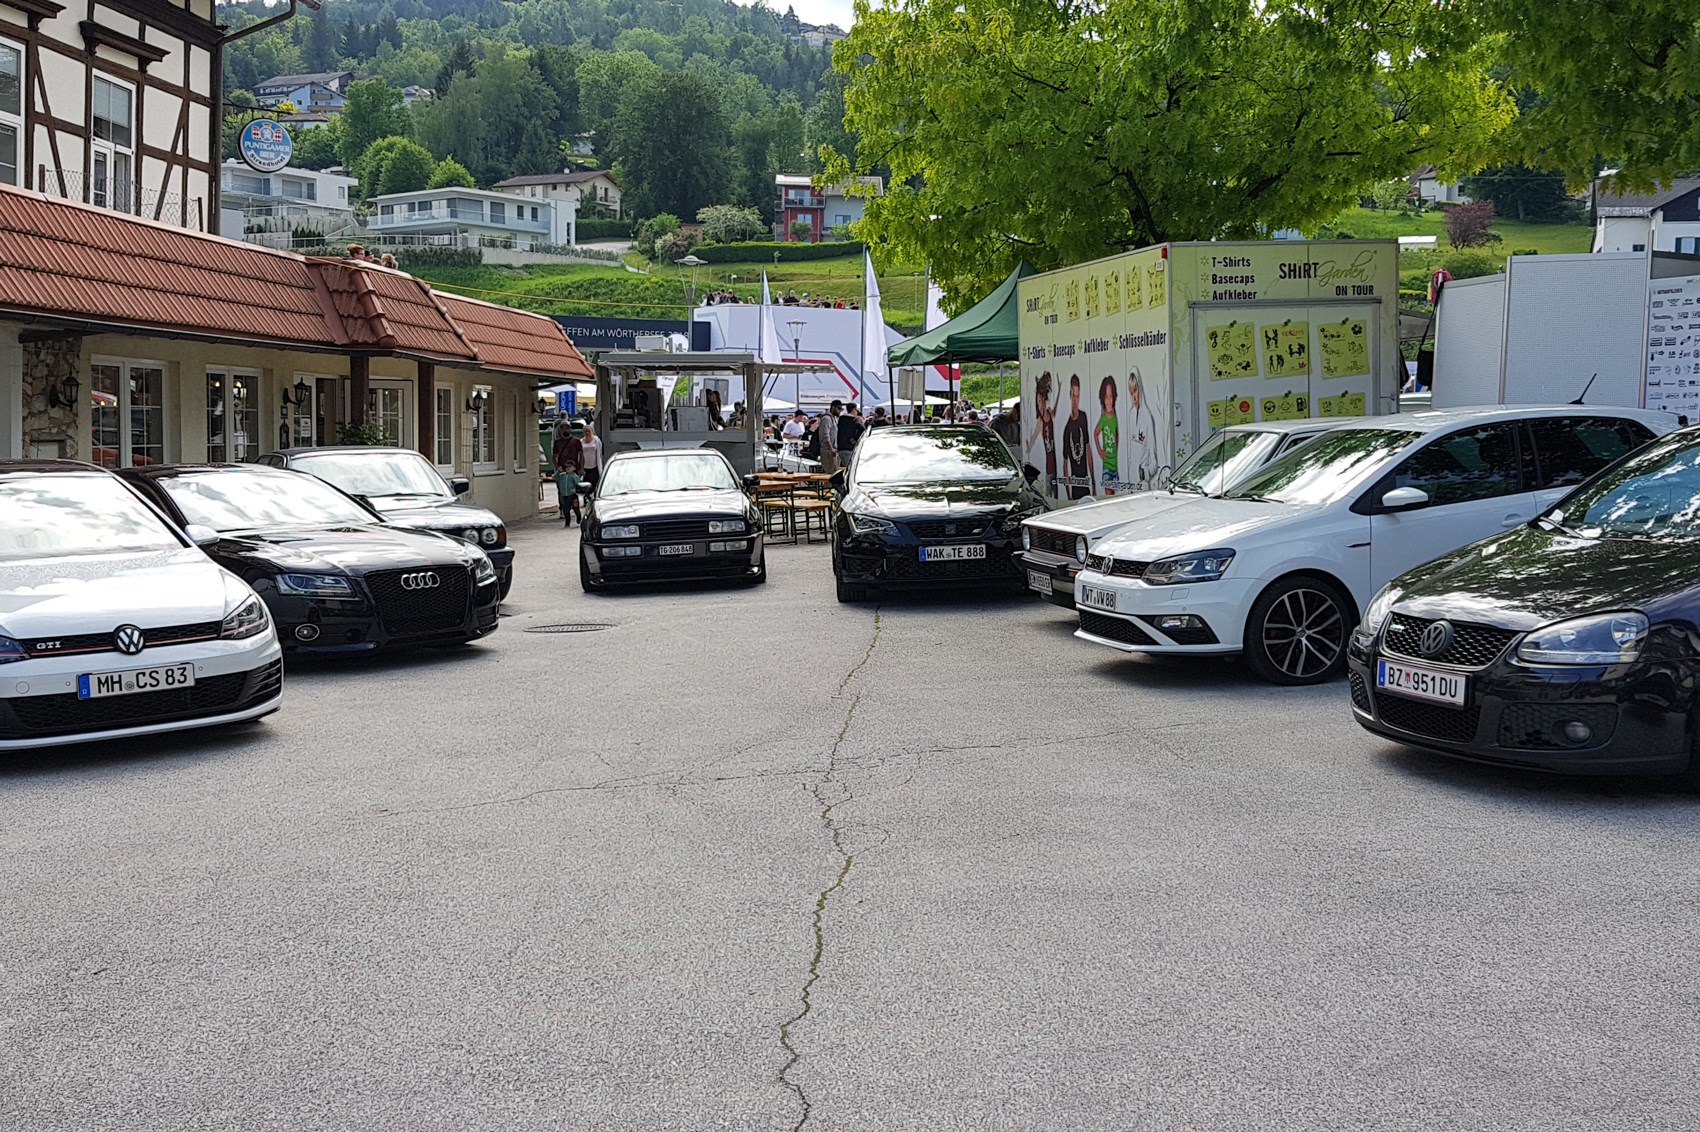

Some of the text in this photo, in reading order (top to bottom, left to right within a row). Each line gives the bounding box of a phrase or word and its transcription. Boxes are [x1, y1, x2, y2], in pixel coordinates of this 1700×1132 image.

[245, 141, 290, 152] PUNTIGAMER
[249, 153, 286, 167] Strandhotel
[1211, 256, 1251, 267] T-Shirts
[1211, 273, 1255, 286] Basecaps
[1212, 290, 1258, 300] Aufkleber
[1335, 285, 1374, 296] ON TOUR
[591, 328, 605, 337] AM
[1027, 329, 1167, 360] T-Shirts Basecaps Aufkleber Schlüsselbänder
[926, 546, 985, 559] WAK TE 888
[1106, 592, 1114, 608] 88
[36, 641, 61, 650] GTI
[97, 674, 123, 694] MH
[135, 670, 161, 689] CS
[165, 667, 188, 686] 83
[1388, 666, 1403, 687] BZ
